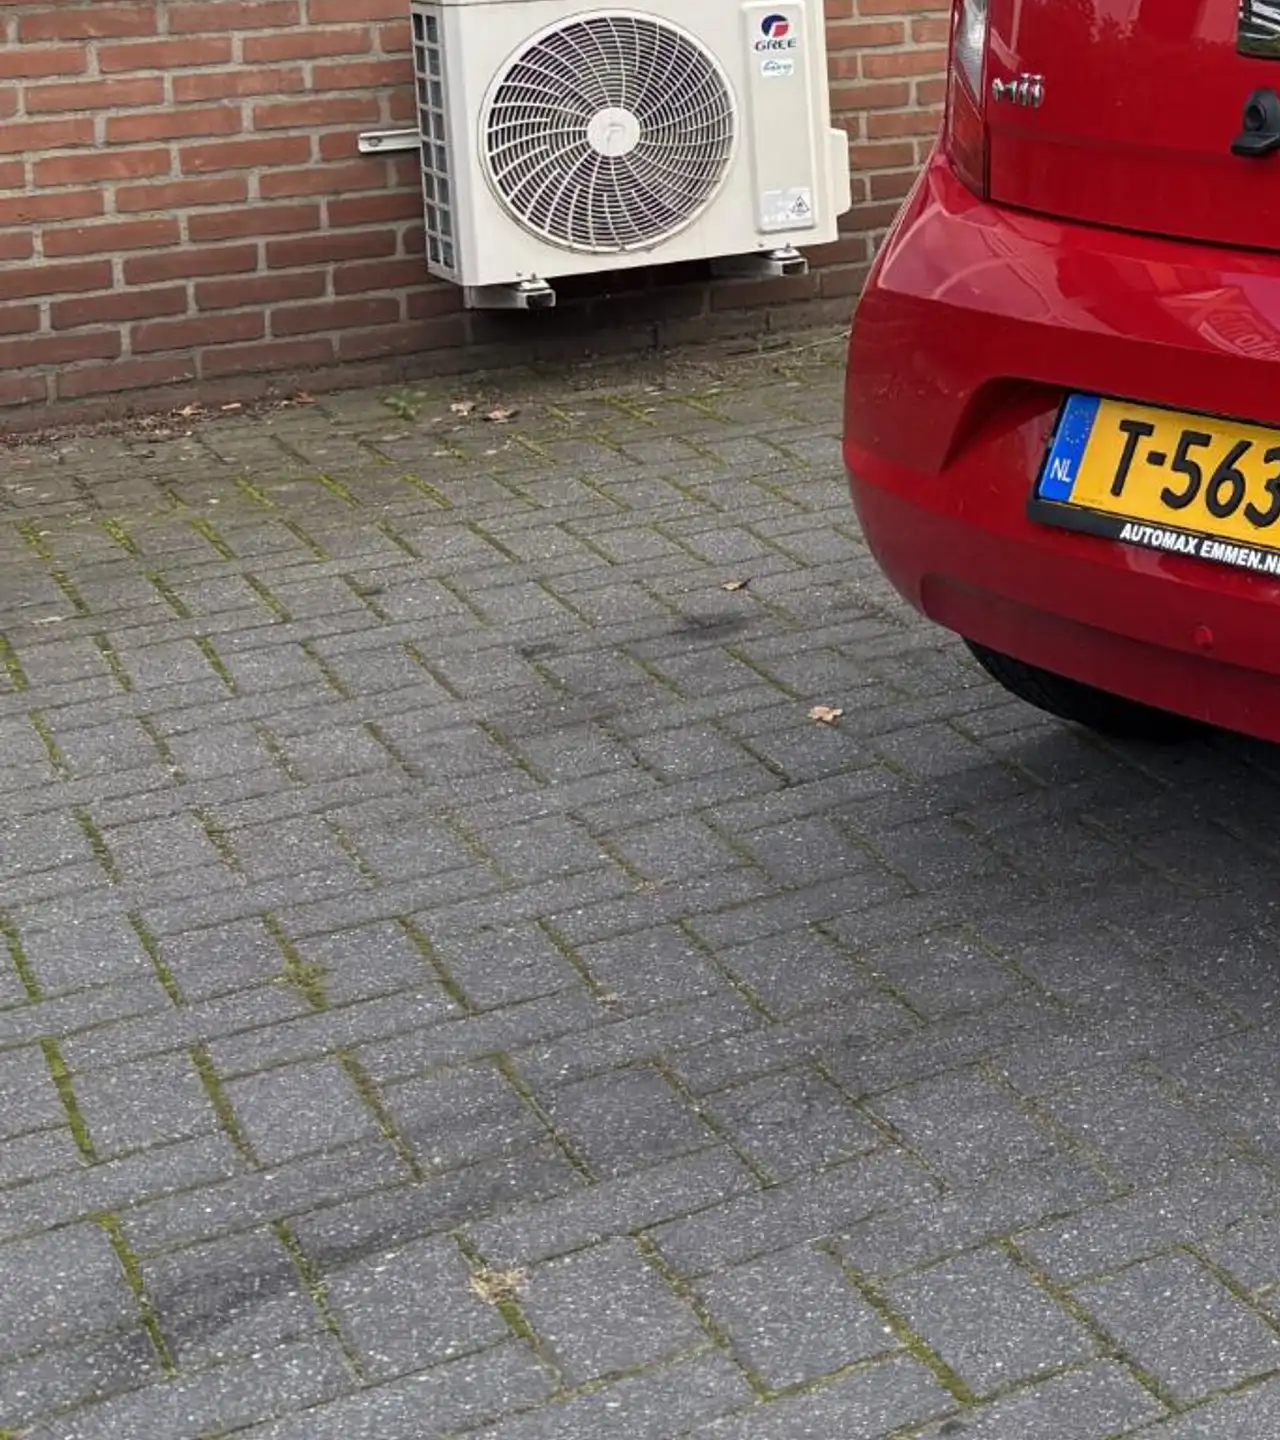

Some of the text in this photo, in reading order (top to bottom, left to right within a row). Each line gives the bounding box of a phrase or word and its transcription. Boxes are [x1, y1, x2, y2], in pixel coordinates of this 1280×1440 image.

[755, 38, 797, 52] GREE
[1049, 456, 1072, 484] NL
[1119, 523, 1199, 555] AUTOMAX
